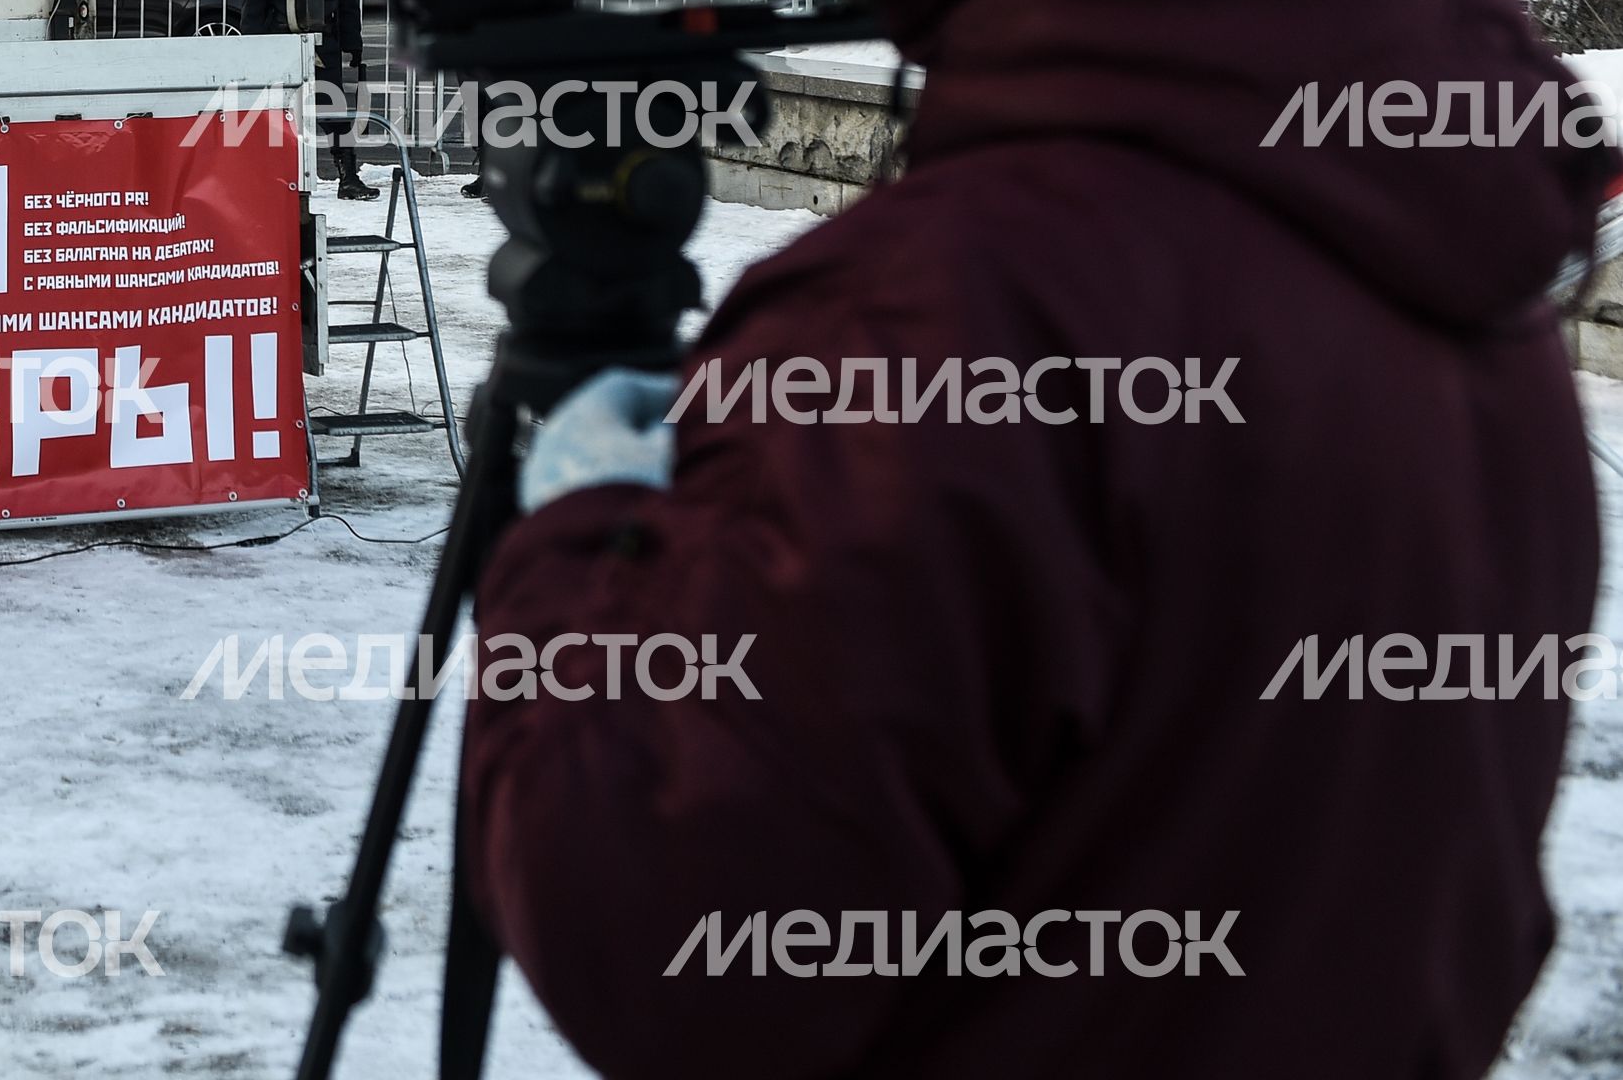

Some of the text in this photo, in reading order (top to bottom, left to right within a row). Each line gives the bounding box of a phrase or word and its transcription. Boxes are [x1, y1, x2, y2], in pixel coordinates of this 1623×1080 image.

[24, 191, 149, 209] БЕЗ ЧЁРНОГО PR!
[24, 213, 186, 237] БЕЗ ФАЛЬСИФИКАЦИЙ!
[23, 238, 214, 264] БЕЗ БАЛАГАНА НА ДЕБАТАХ!
[23, 261, 280, 290] С РАВНЫМИ ШАНСАМИ КАНДИДАТОВ!
[38, 309, 142, 332] ШАНСАМИ
[147, 297, 277, 326] КАНДИДАТОВ!
